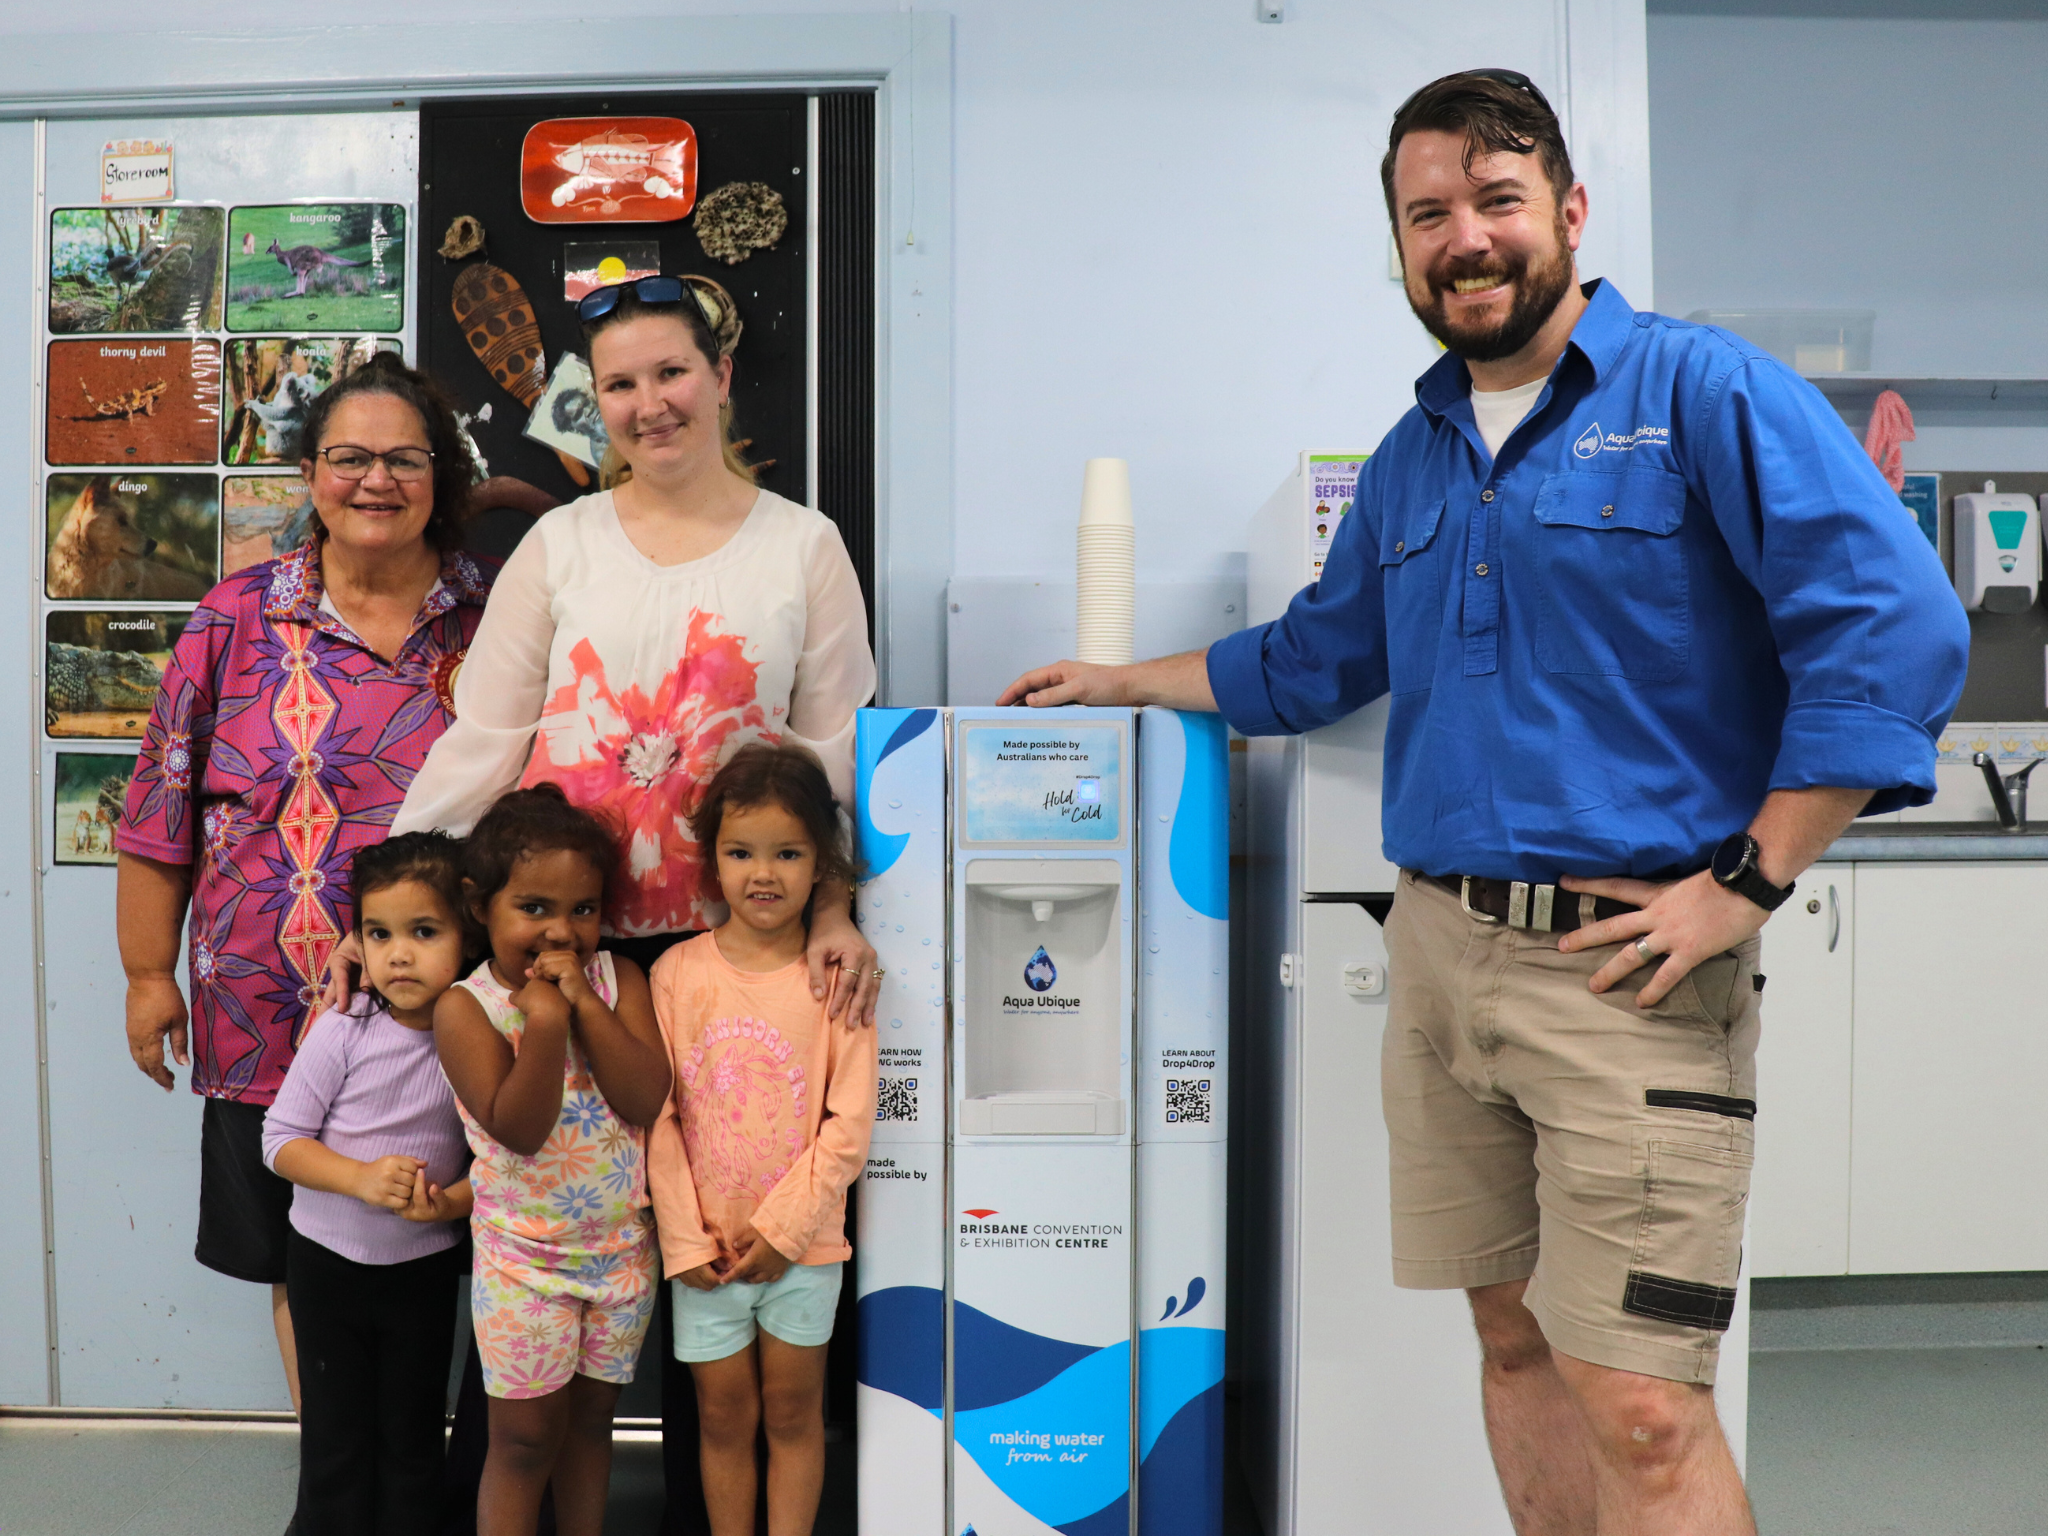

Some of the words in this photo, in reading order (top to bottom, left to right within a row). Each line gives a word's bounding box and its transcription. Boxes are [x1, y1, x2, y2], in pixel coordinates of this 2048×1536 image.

[289, 212, 342, 226] kangaroo
[100, 346, 136, 359] thorny
[140, 346, 166, 357] devil
[296, 345, 327, 357] koala
[1605, 432, 1635, 445] Aqua
[1635, 424, 1669, 437] bique
[118, 481, 148, 495] dingo
[108, 619, 156, 631] crocodile
[1003, 740, 1028, 749] Made
[1030, 740, 1067, 750] possible
[1069, 740, 1080, 751] by
[996, 753, 1047, 761] Australians
[1049, 753, 1067, 761] who
[1043, 789, 1074, 810] Hold
[1061, 806, 1071, 816] for
[1071, 804, 1102, 823] Cold
[1002, 995, 1034, 1009] Aqua
[1037, 995, 1081, 1009] Ubique
[900, 1048, 922, 1056] HOW
[1162, 1049, 1188, 1057] LEARN
[1189, 1049, 1216, 1057] ABOUT
[893, 1058, 922, 1067] works
[1162, 1059, 1215, 1070] Drop4Drop
[867, 1158, 896, 1167] made
[867, 1169, 911, 1180] possible
[913, 1169, 927, 1181] by
[960, 1224, 1028, 1234] BRISBANE
[1033, 1225, 1123, 1235] CONVENTION
[960, 1238, 970, 1248] &
[974, 1238, 1050, 1248] EXHIBITION
[1055, 1238, 1109, 1248] CENTRE
[989, 1430, 1051, 1449] making
[1054, 1432, 1105, 1446] water
[1005, 1447, 1053, 1466] from
[1059, 1448, 1088, 1463] air
